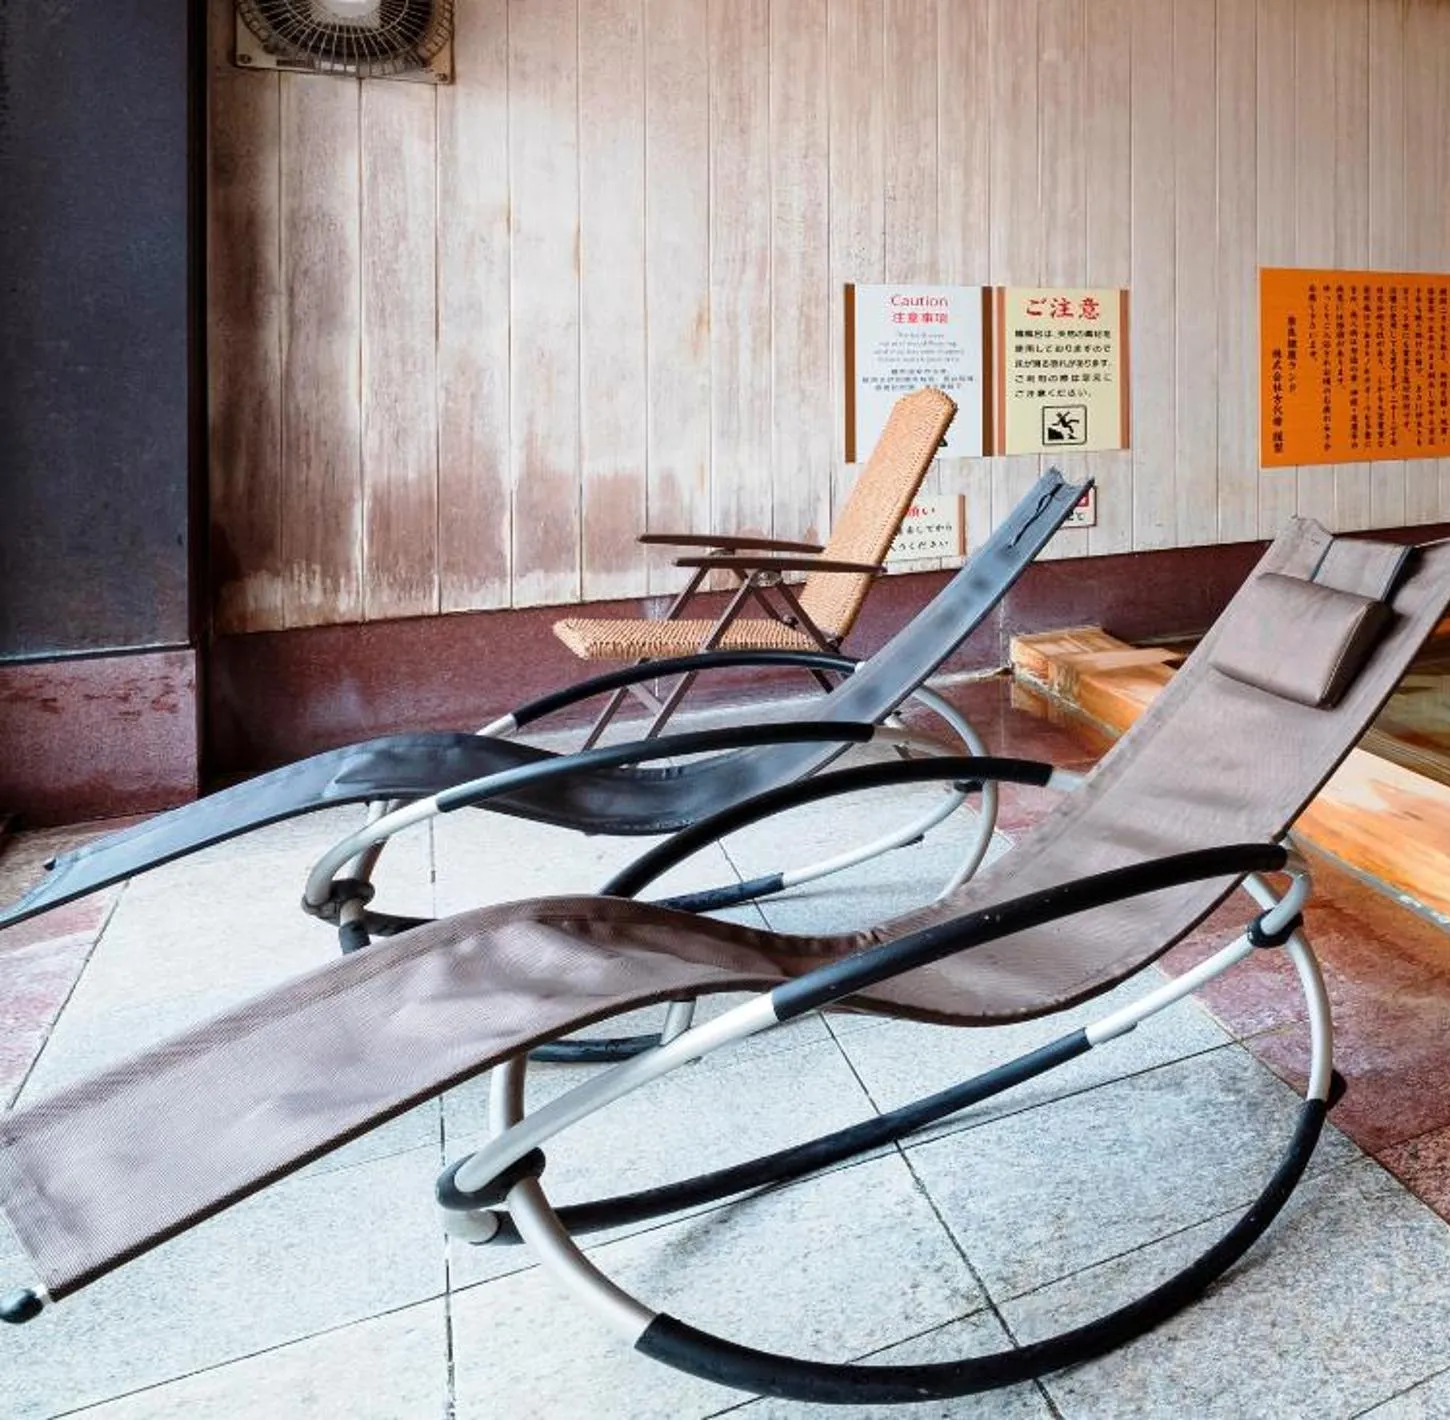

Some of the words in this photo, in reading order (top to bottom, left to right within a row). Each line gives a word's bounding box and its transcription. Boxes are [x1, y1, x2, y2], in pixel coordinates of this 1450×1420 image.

[891, 294, 949, 308] Caution
[1026, 297, 1100, 320] ご注意
[892, 312, 949, 324] 注意事項
[1014, 344, 1111, 353] 使用しておりますので
